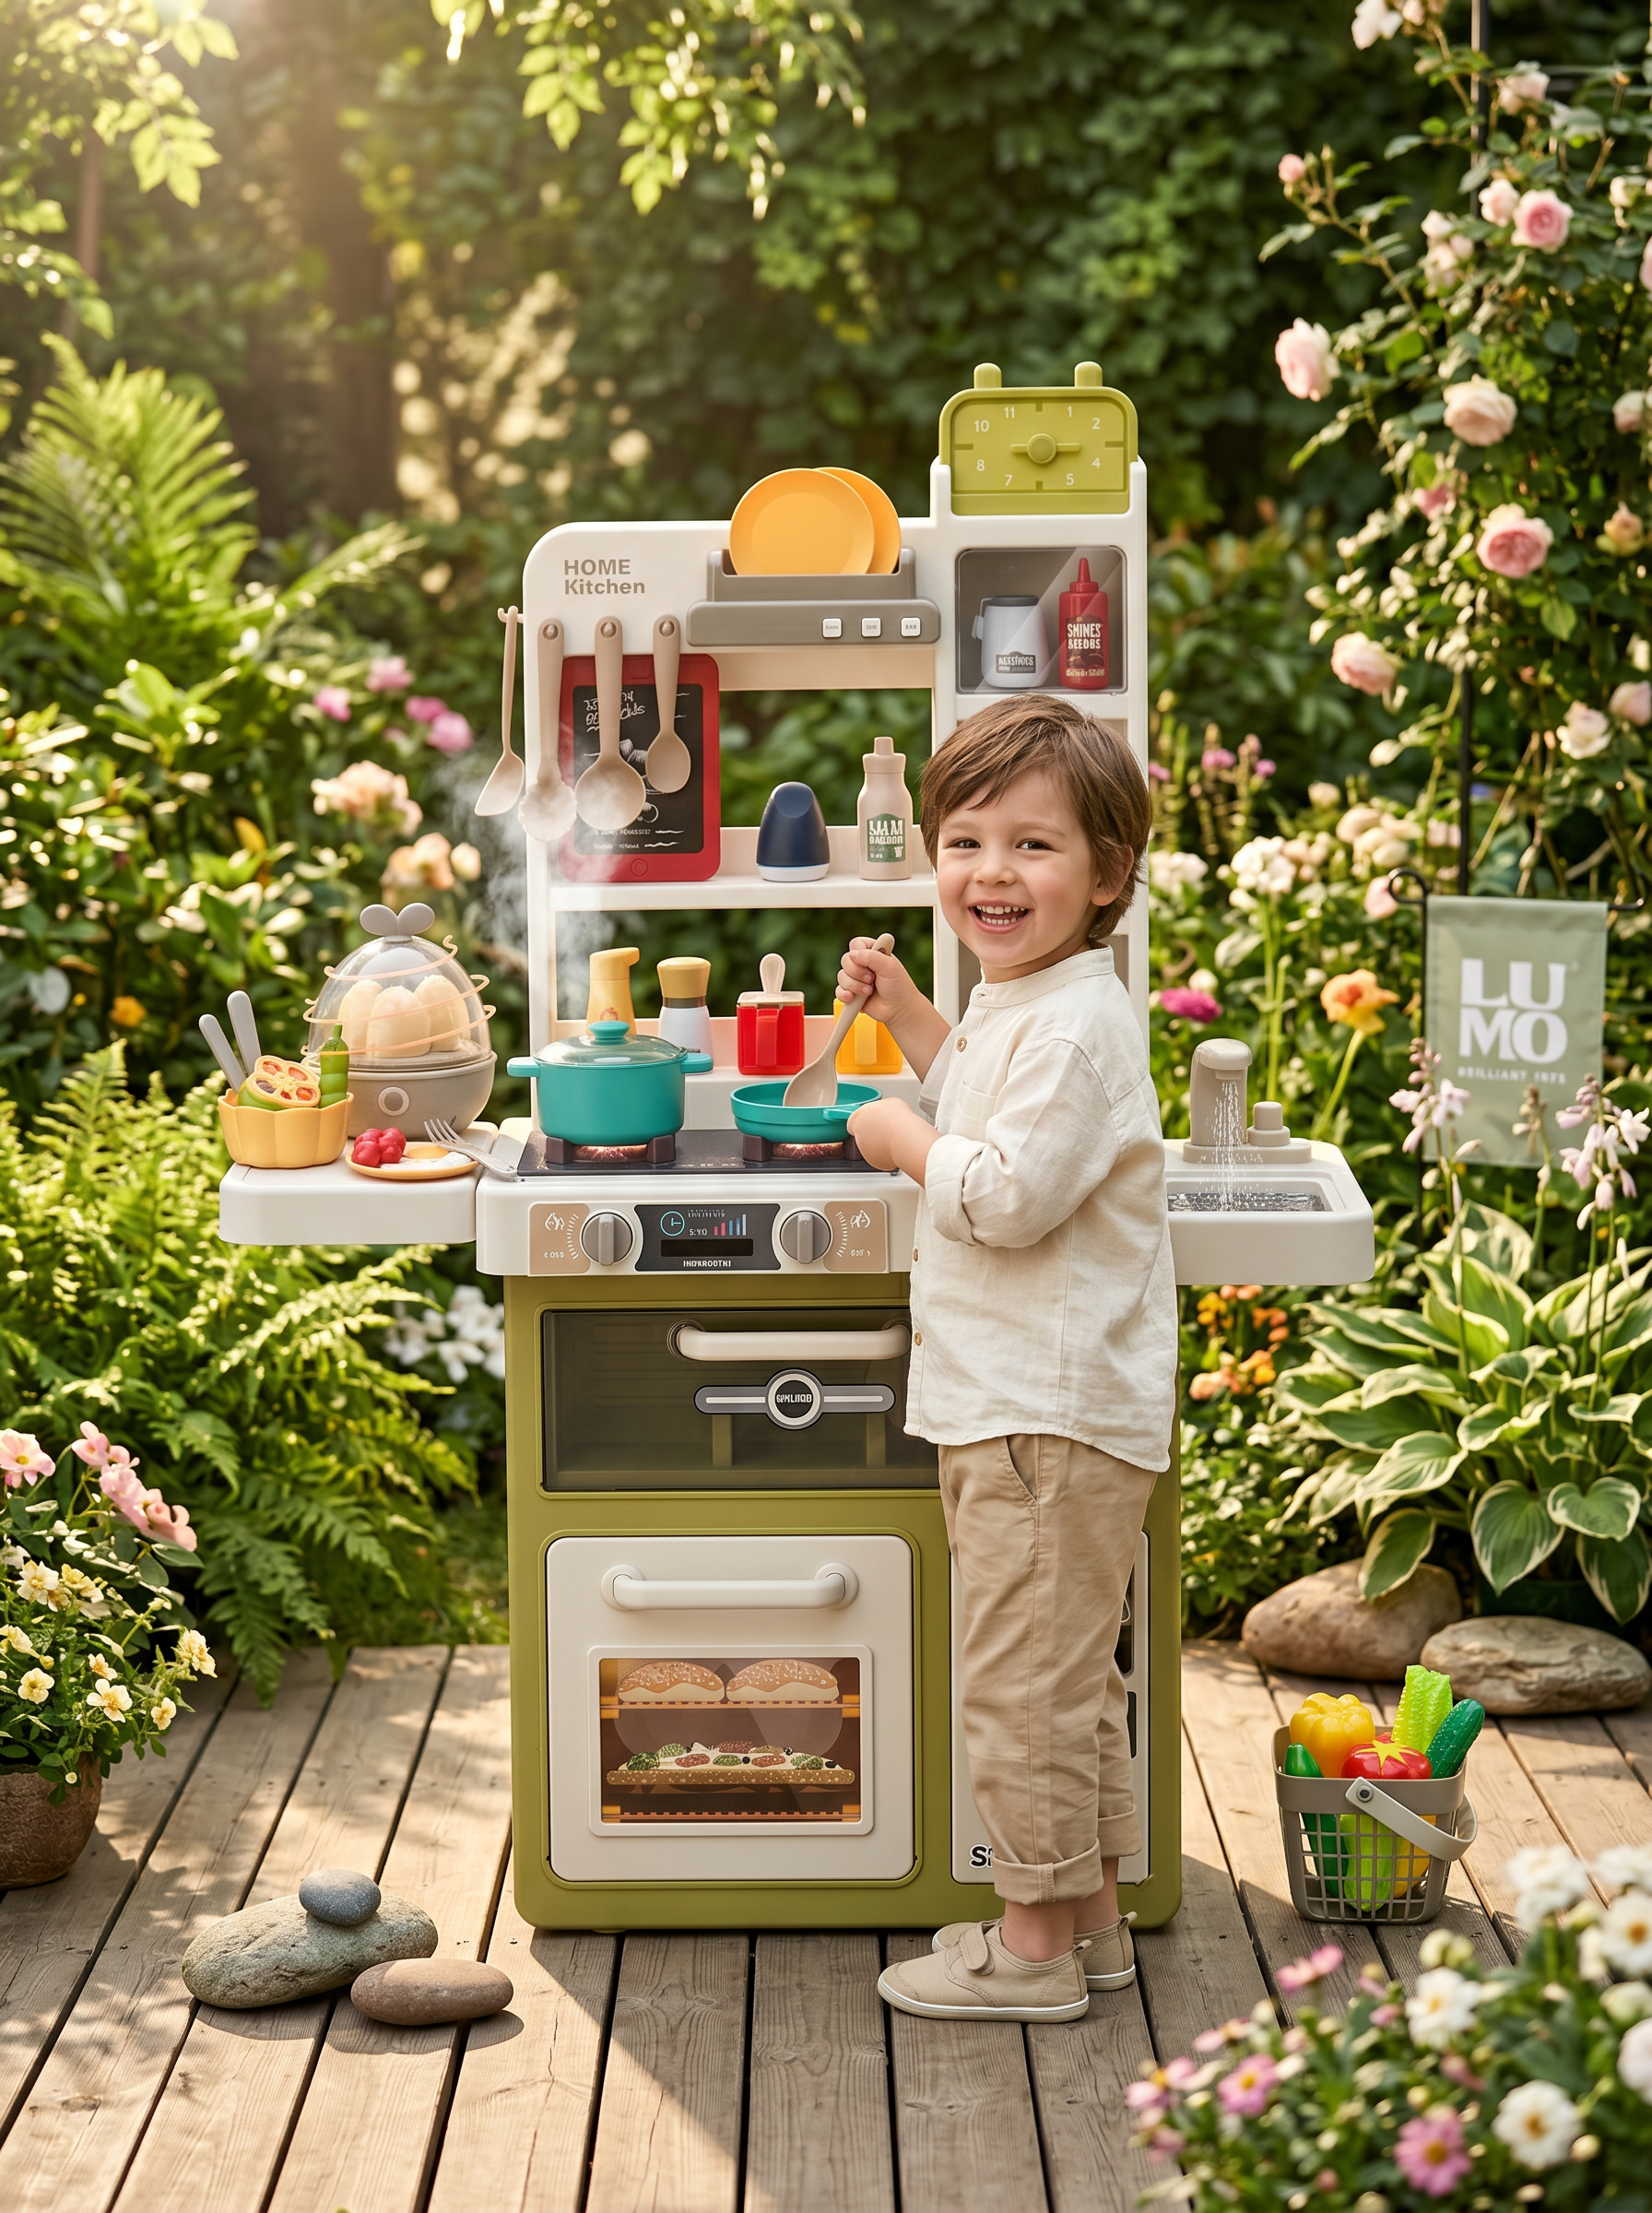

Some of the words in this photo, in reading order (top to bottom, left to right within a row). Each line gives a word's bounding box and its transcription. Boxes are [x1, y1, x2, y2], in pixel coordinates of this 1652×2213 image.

[1004, 408, 1015, 419] 11
[1067, 406, 1072, 417] 1
[974, 420, 989, 432] 10
[1092, 418, 1100, 429] 2
[976, 459, 985, 471] 8
[1092, 457, 1101, 468] 4
[1005, 475, 1012, 486] 7
[1067, 474, 1074, 485] 5
[564, 559, 631, 575] HOME
[565, 578, 645, 595] Kitchen
[1460, 958, 1566, 1011] LU
[1458, 1007, 1568, 1064] MO
